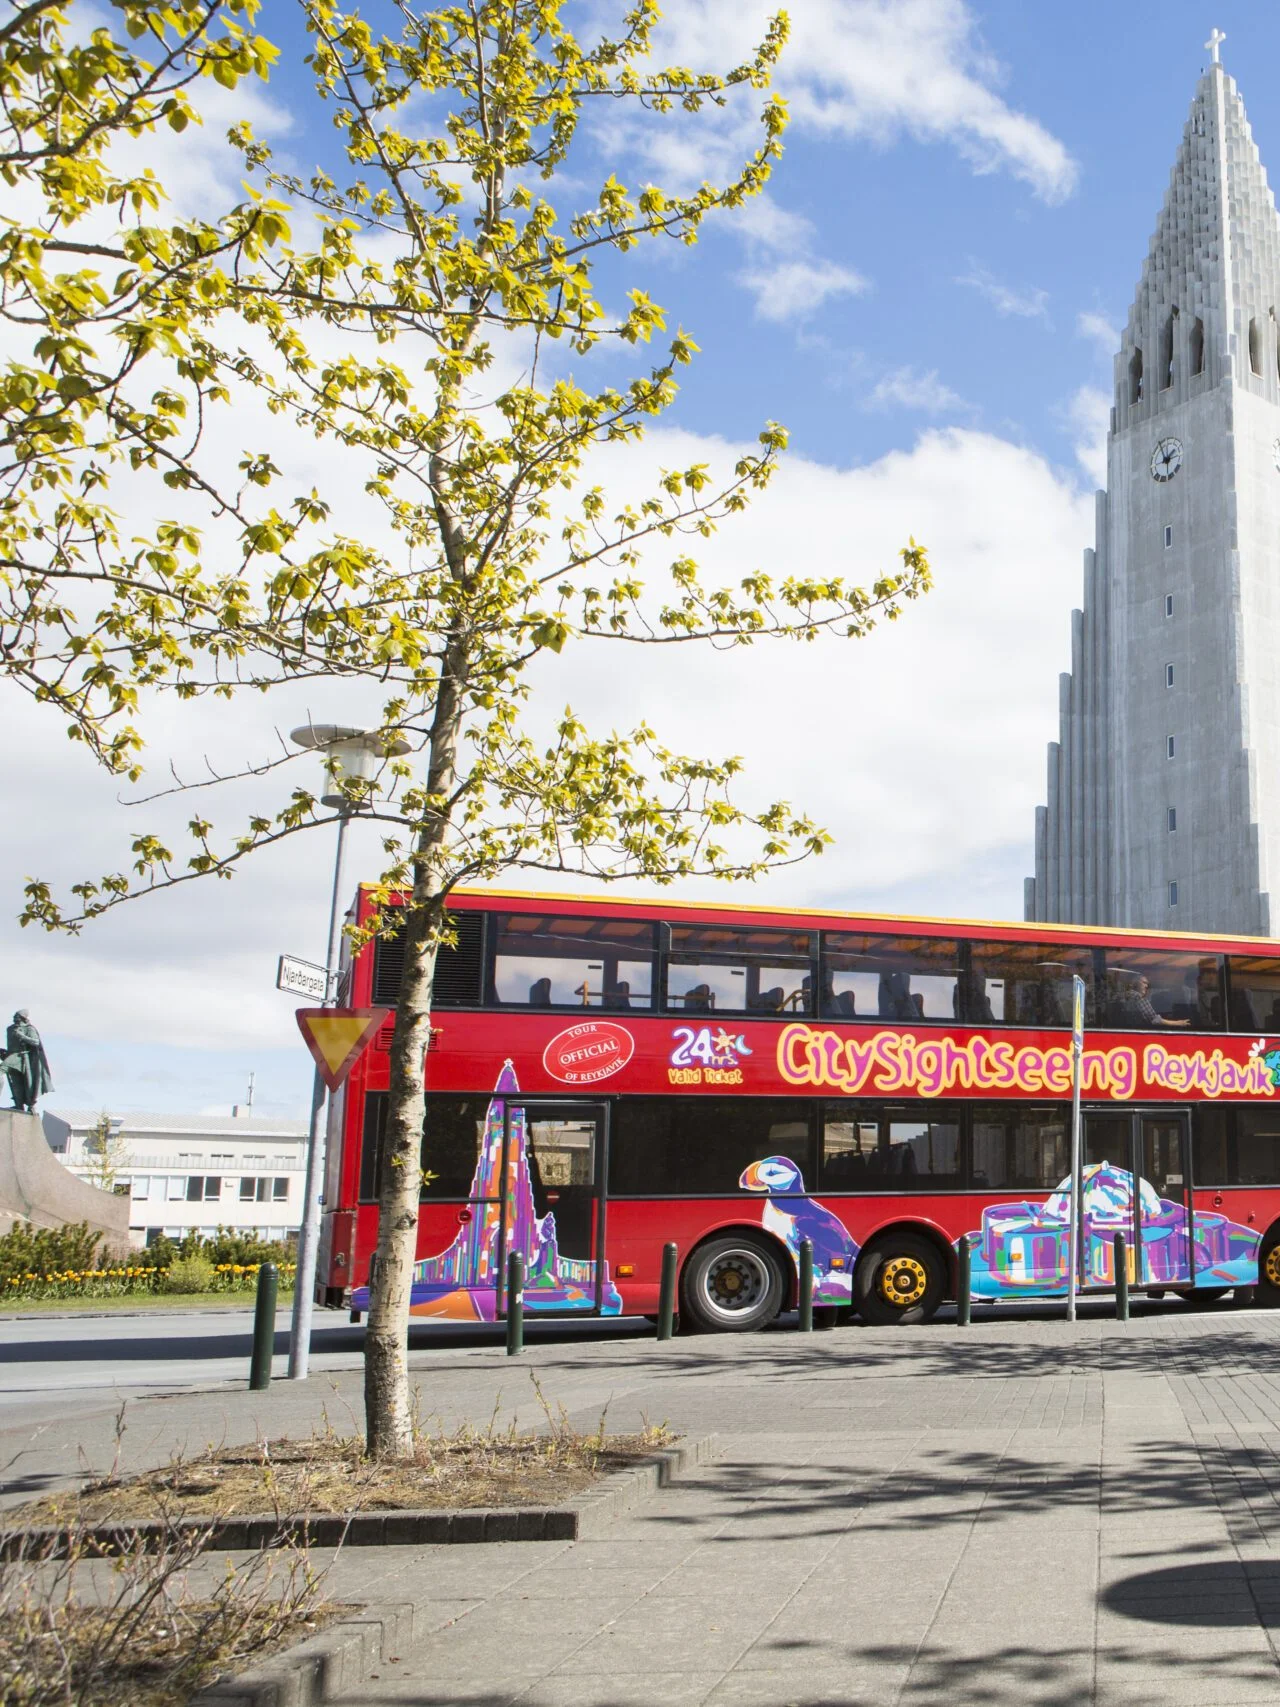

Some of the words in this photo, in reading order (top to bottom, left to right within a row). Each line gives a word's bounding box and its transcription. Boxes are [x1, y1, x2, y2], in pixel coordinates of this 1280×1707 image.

[568, 1024, 597, 1038] TOUR
[560, 1040, 618, 1065] OFFICIAL
[671, 1027, 714, 1066] 24
[565, 1072, 579, 1081] OF
[581, 1057, 625, 1081] REYKJAVIK
[777, 1023, 1136, 1099] CitySightseeng
[1144, 1044, 1275, 1098] Reykjavik
[668, 1068, 701, 1085] Valid
[704, 1068, 743, 1085] Ticket
